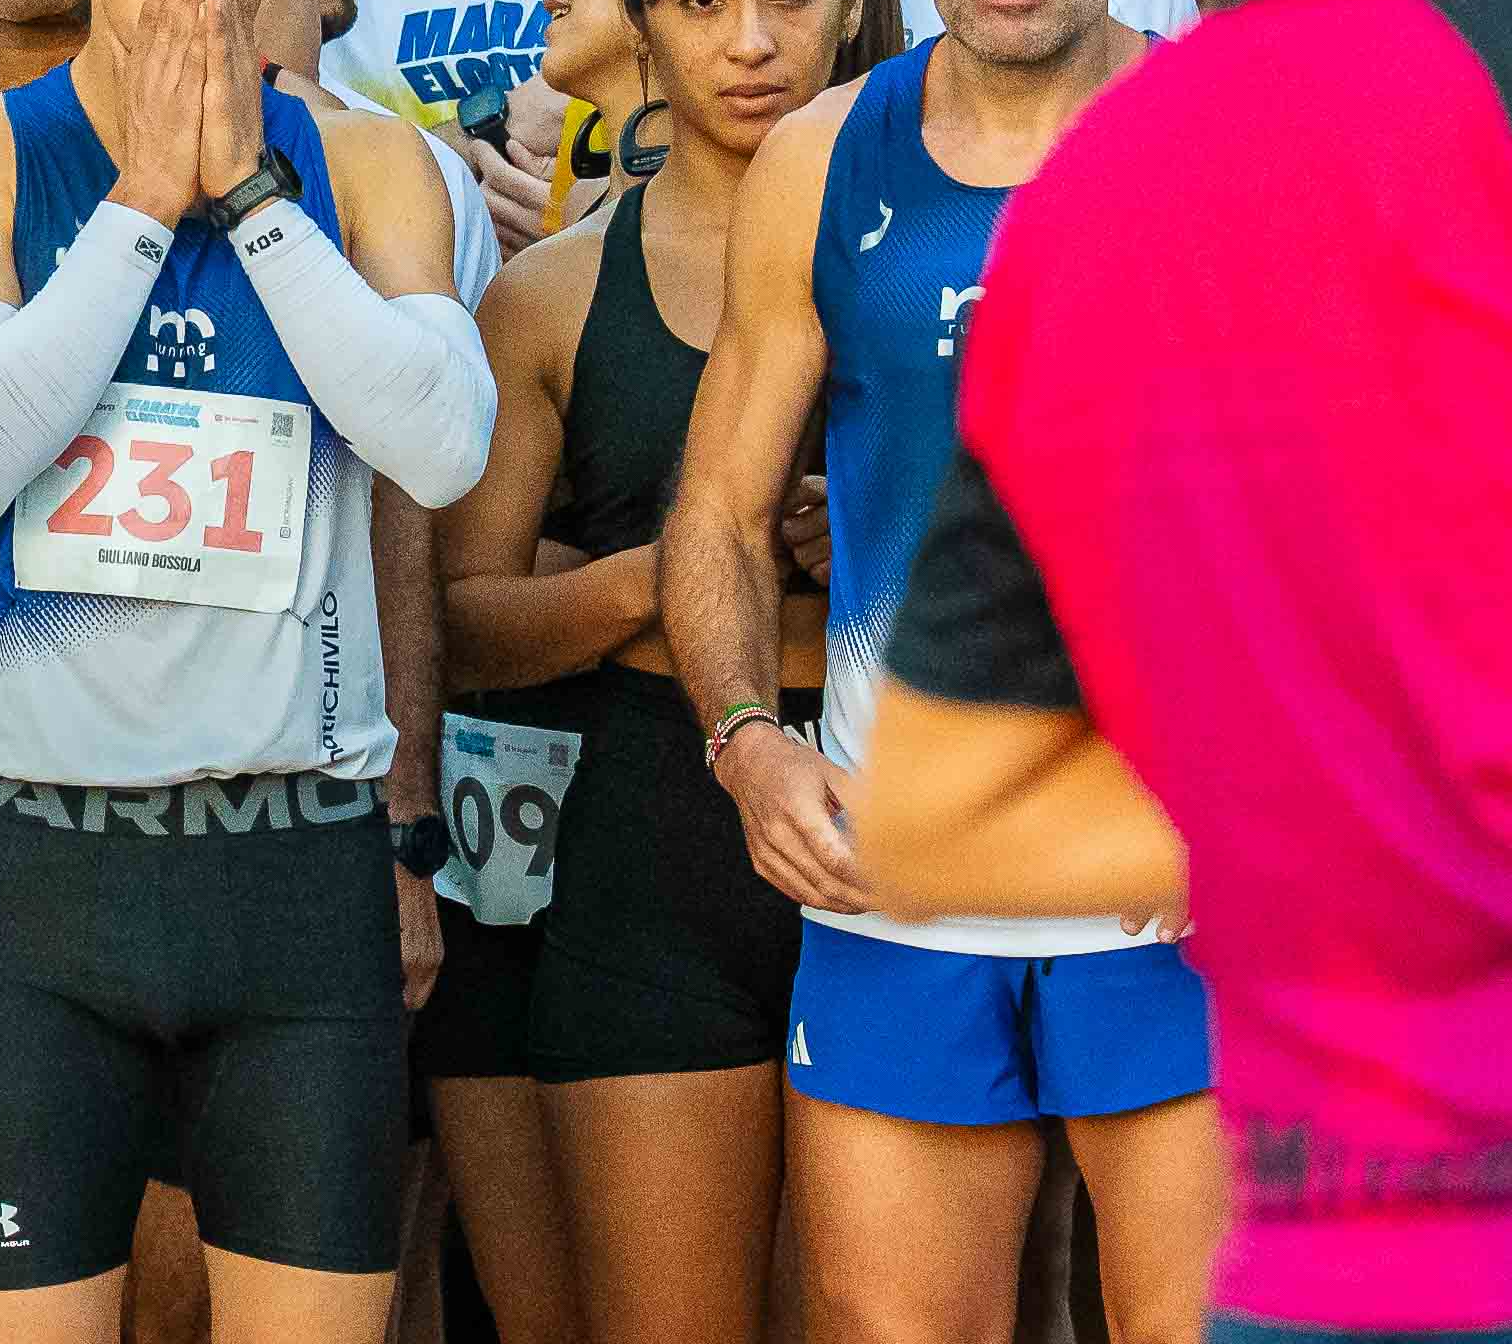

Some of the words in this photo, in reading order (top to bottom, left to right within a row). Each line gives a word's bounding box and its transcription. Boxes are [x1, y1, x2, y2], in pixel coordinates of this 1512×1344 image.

[47, 434, 263, 553] 231
[98, 548, 149, 567] GIULIANO
[151, 556, 201, 572] BOSSOLA
